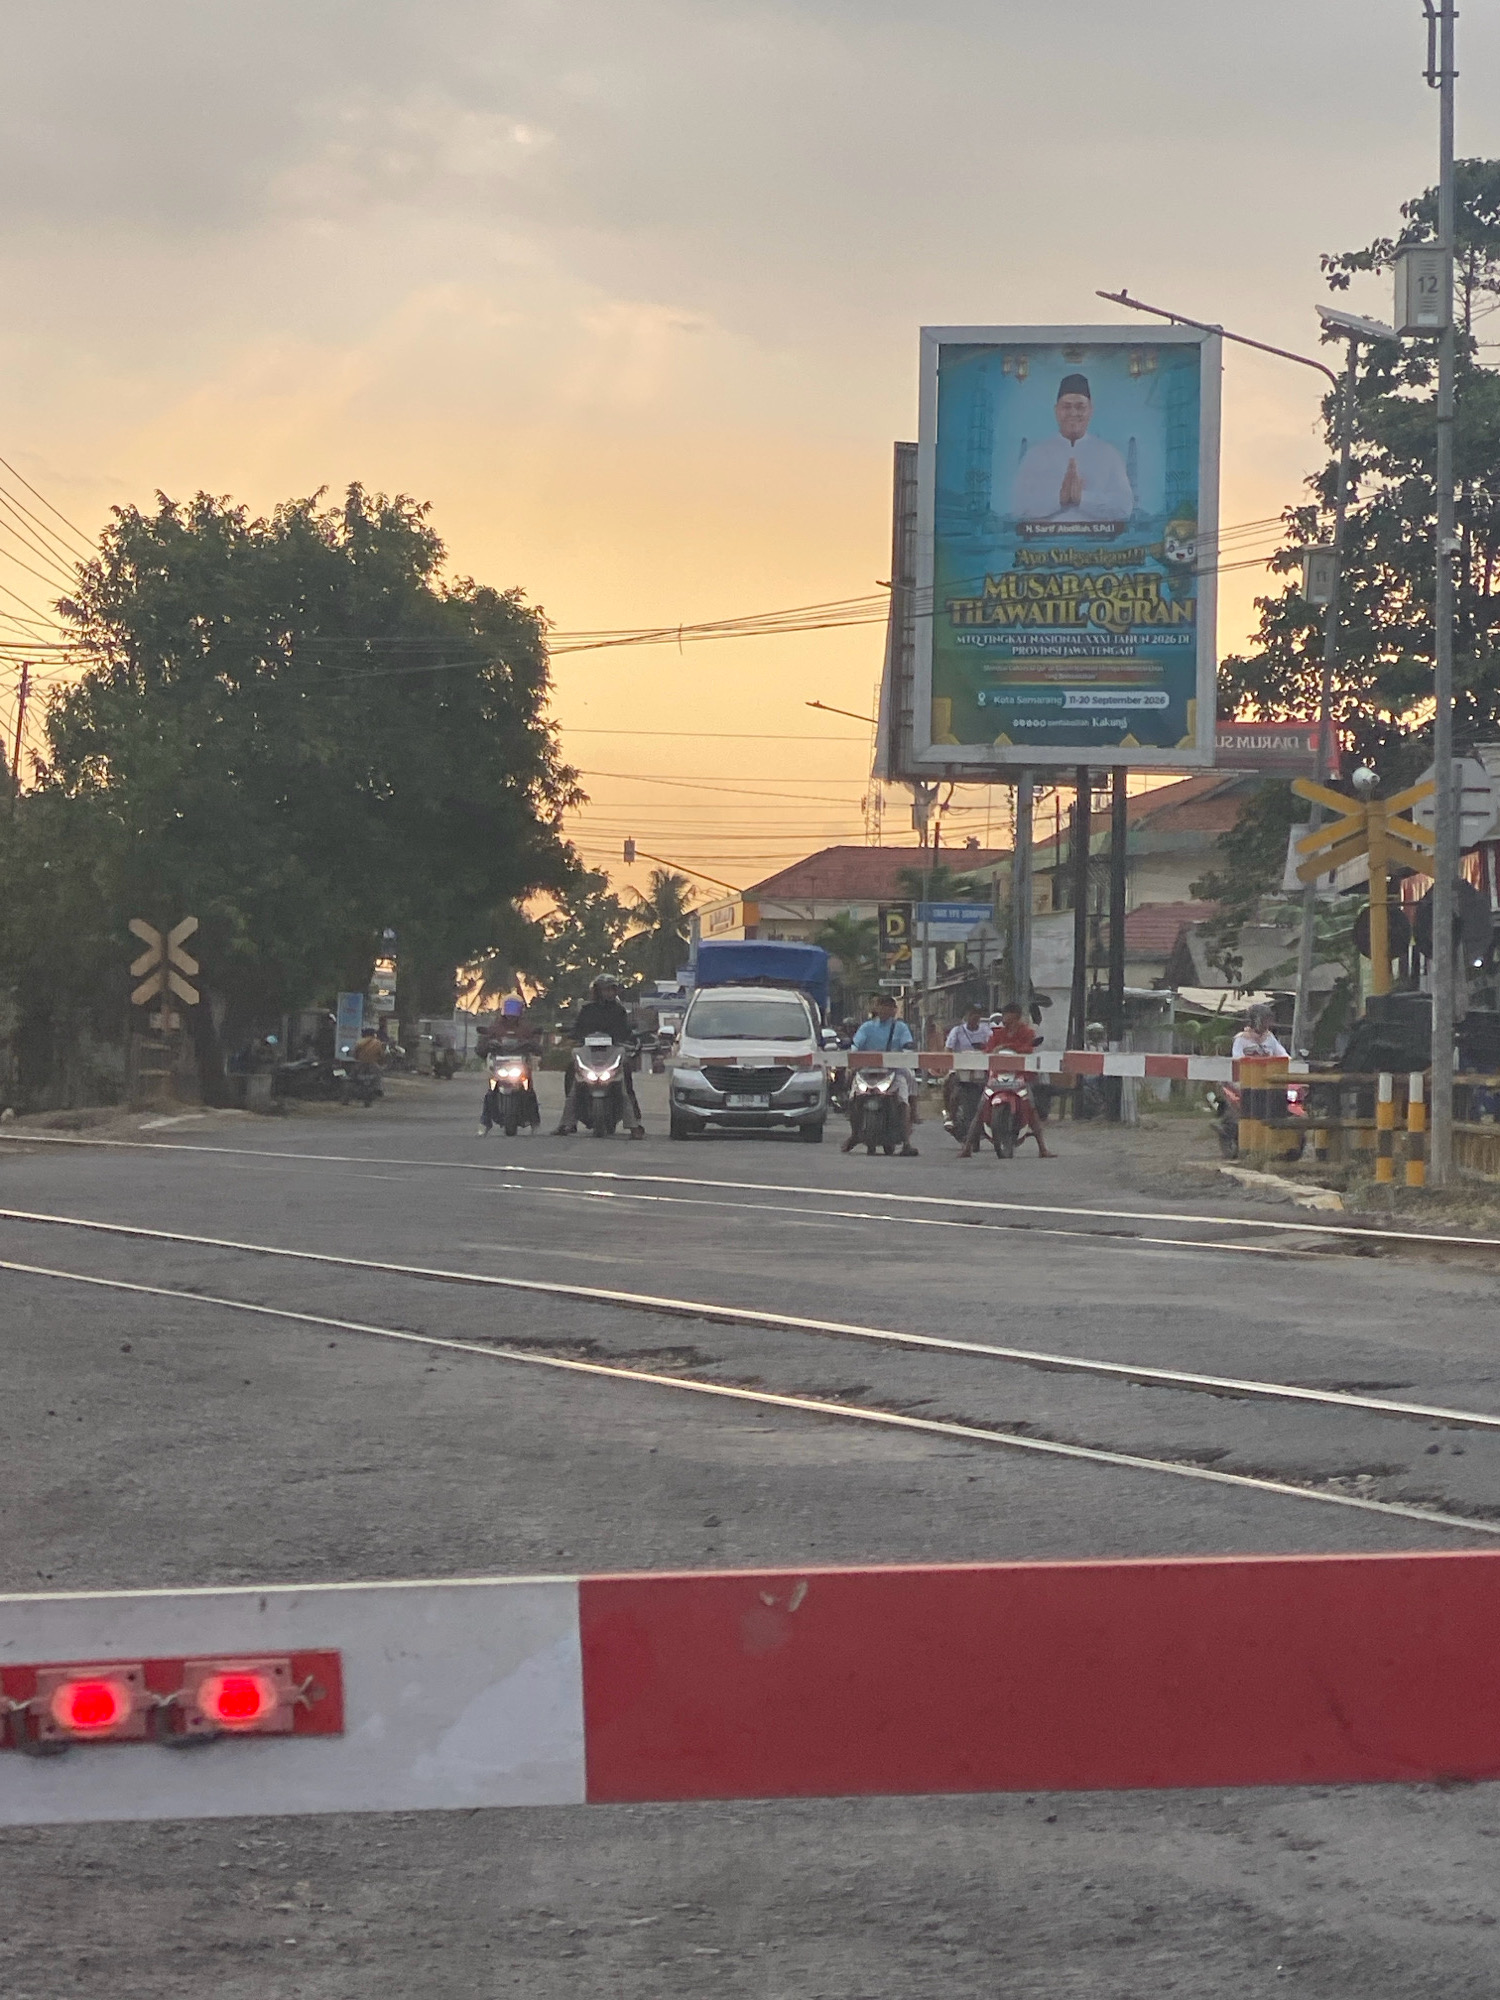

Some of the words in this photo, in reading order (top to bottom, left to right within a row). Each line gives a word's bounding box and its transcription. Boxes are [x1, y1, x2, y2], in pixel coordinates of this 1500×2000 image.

[1417, 276, 1439, 293] 12
[984, 573, 1161, 606] MUSABAQAH
[951, 599, 1088, 624] TILAWATIL
[984, 635, 1027, 645] TINGKAT
[1029, 635, 1084, 645] NASIONAL
[1115, 635, 1149, 645] TAHUN
[1152, 634, 1176, 645] 2026
[1178, 634, 1190, 645] DI
[1012, 646, 1062, 656] PROVINSI
[1062, 646, 1088, 657] JAWA
[1091, 646, 1134, 656] TENGAH
[994, 696, 1014, 705] Kota
[1016, 696, 1062, 707] Semarang
[1092, 696, 1141, 707] September
[1144, 696, 1166, 705] 2026
